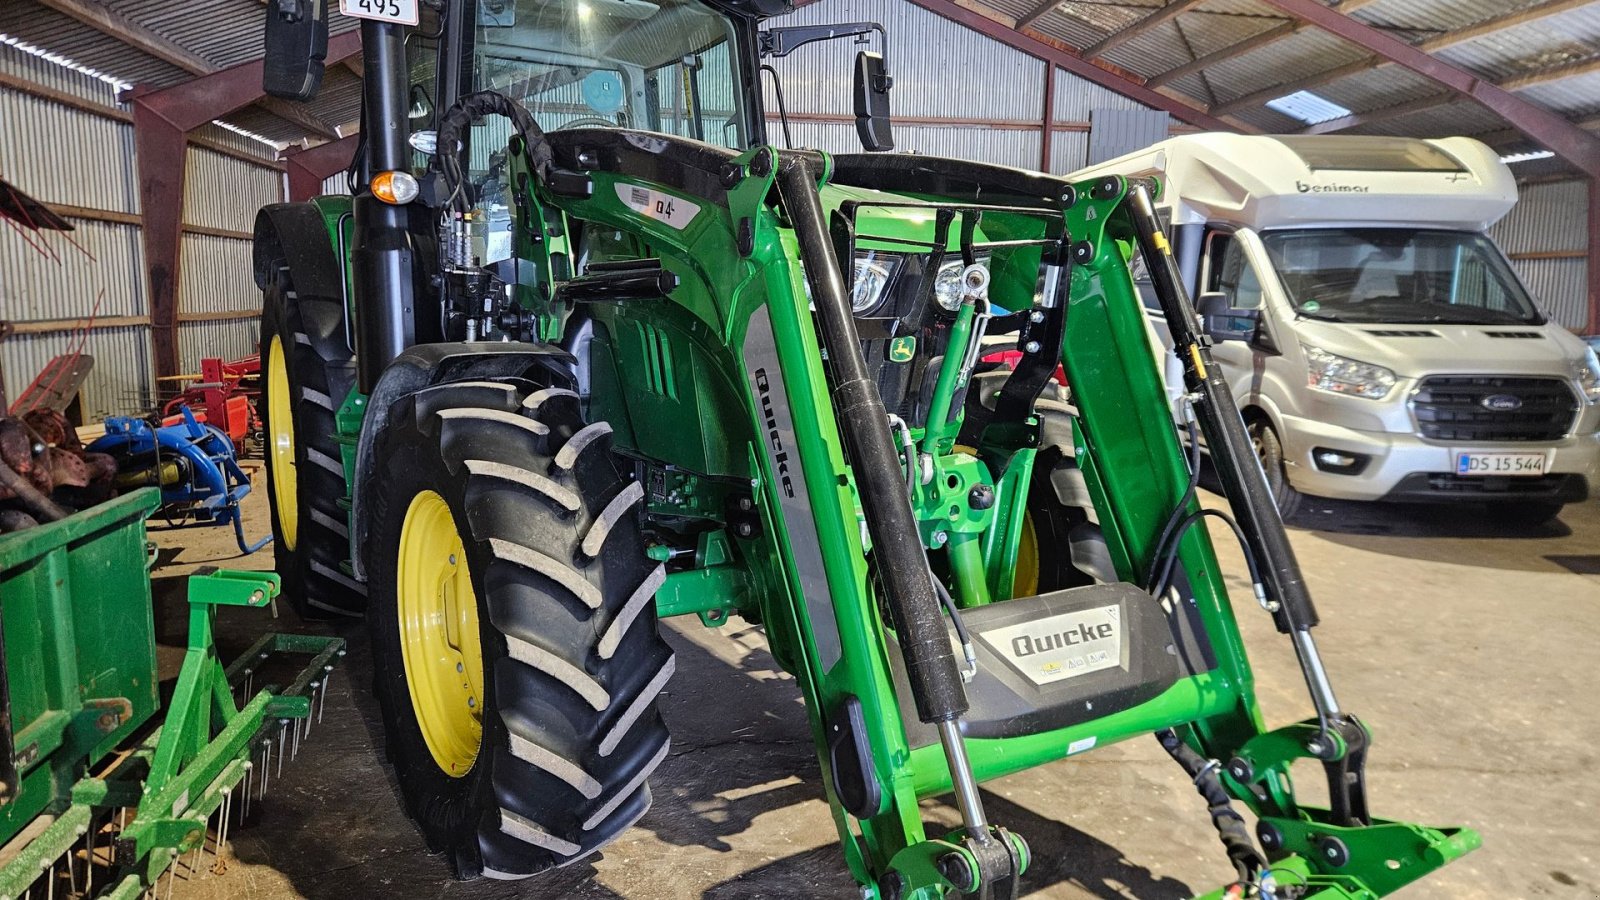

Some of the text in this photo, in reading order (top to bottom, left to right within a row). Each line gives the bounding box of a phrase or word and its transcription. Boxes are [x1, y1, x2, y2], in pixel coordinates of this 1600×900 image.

[359, 0, 400, 17] 495
[1296, 180, 1370, 193] benimar
[755, 367, 795, 499] Quicke
[1469, 457, 1489, 471] DS
[1495, 457, 1511, 471] 15
[1515, 457, 1542, 471] 544
[1011, 622, 1113, 658] Quicke
